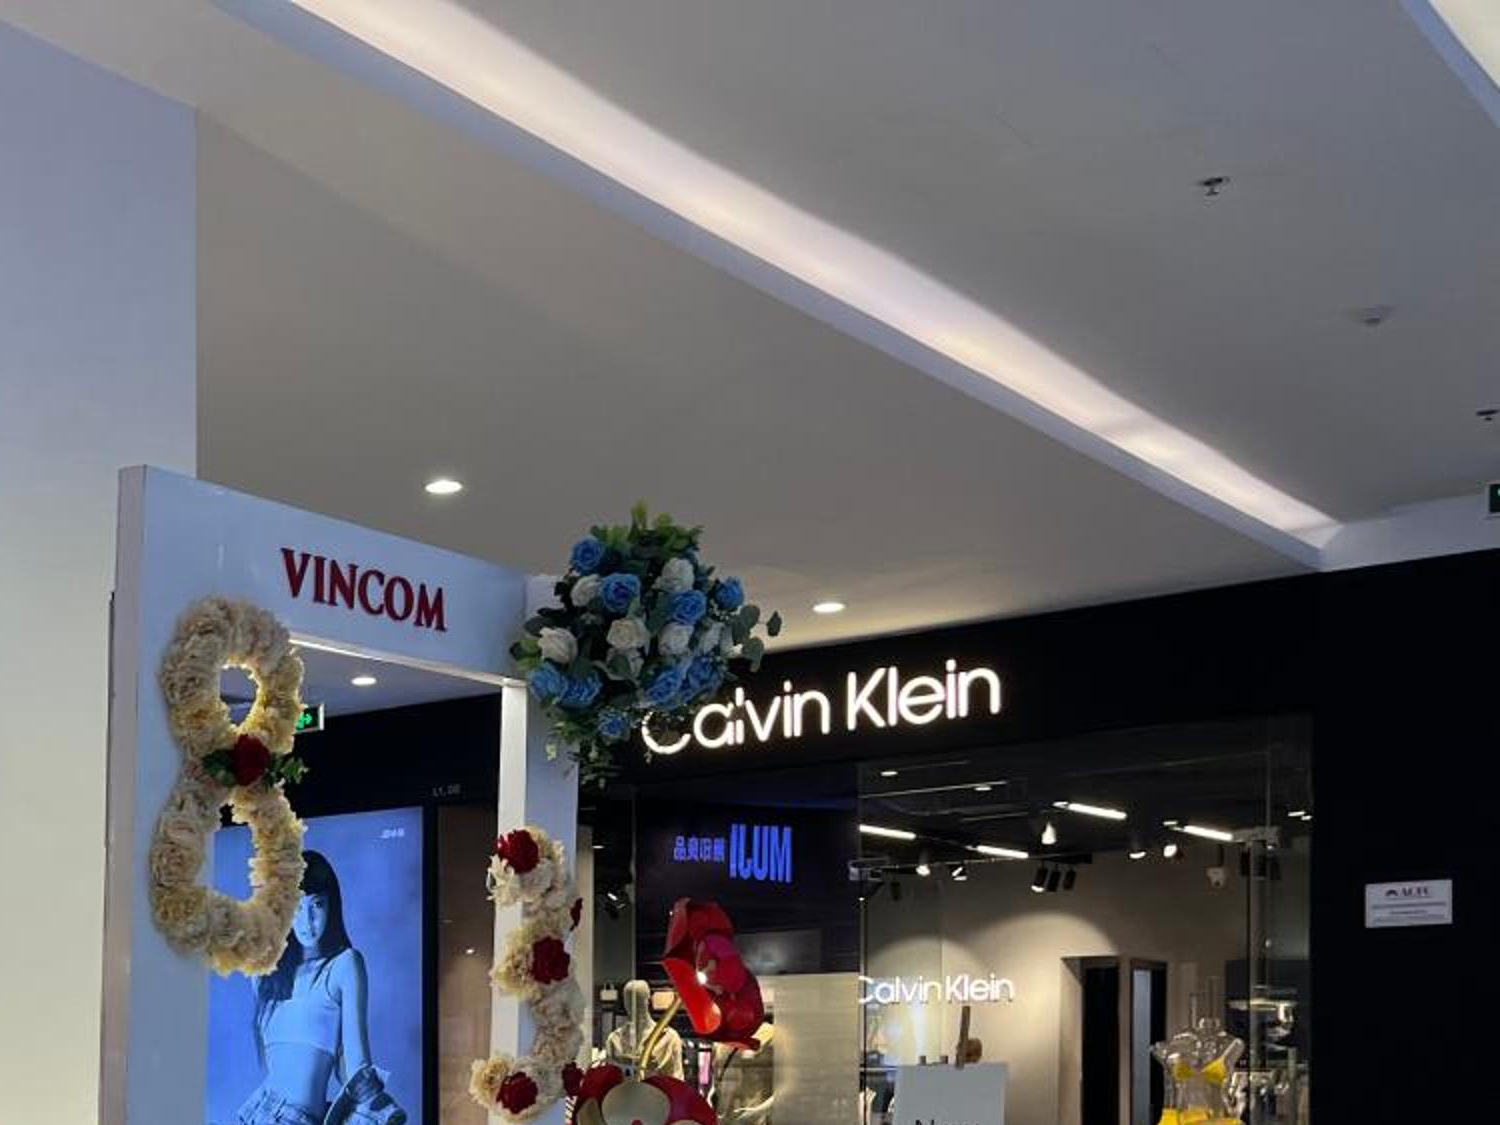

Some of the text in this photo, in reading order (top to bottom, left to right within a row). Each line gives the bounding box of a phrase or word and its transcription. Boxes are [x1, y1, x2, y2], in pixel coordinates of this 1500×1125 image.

[281, 548, 447, 631] VINCOM
[846, 659, 1000, 731] Klein
[946, 973, 1013, 1002] Klein
